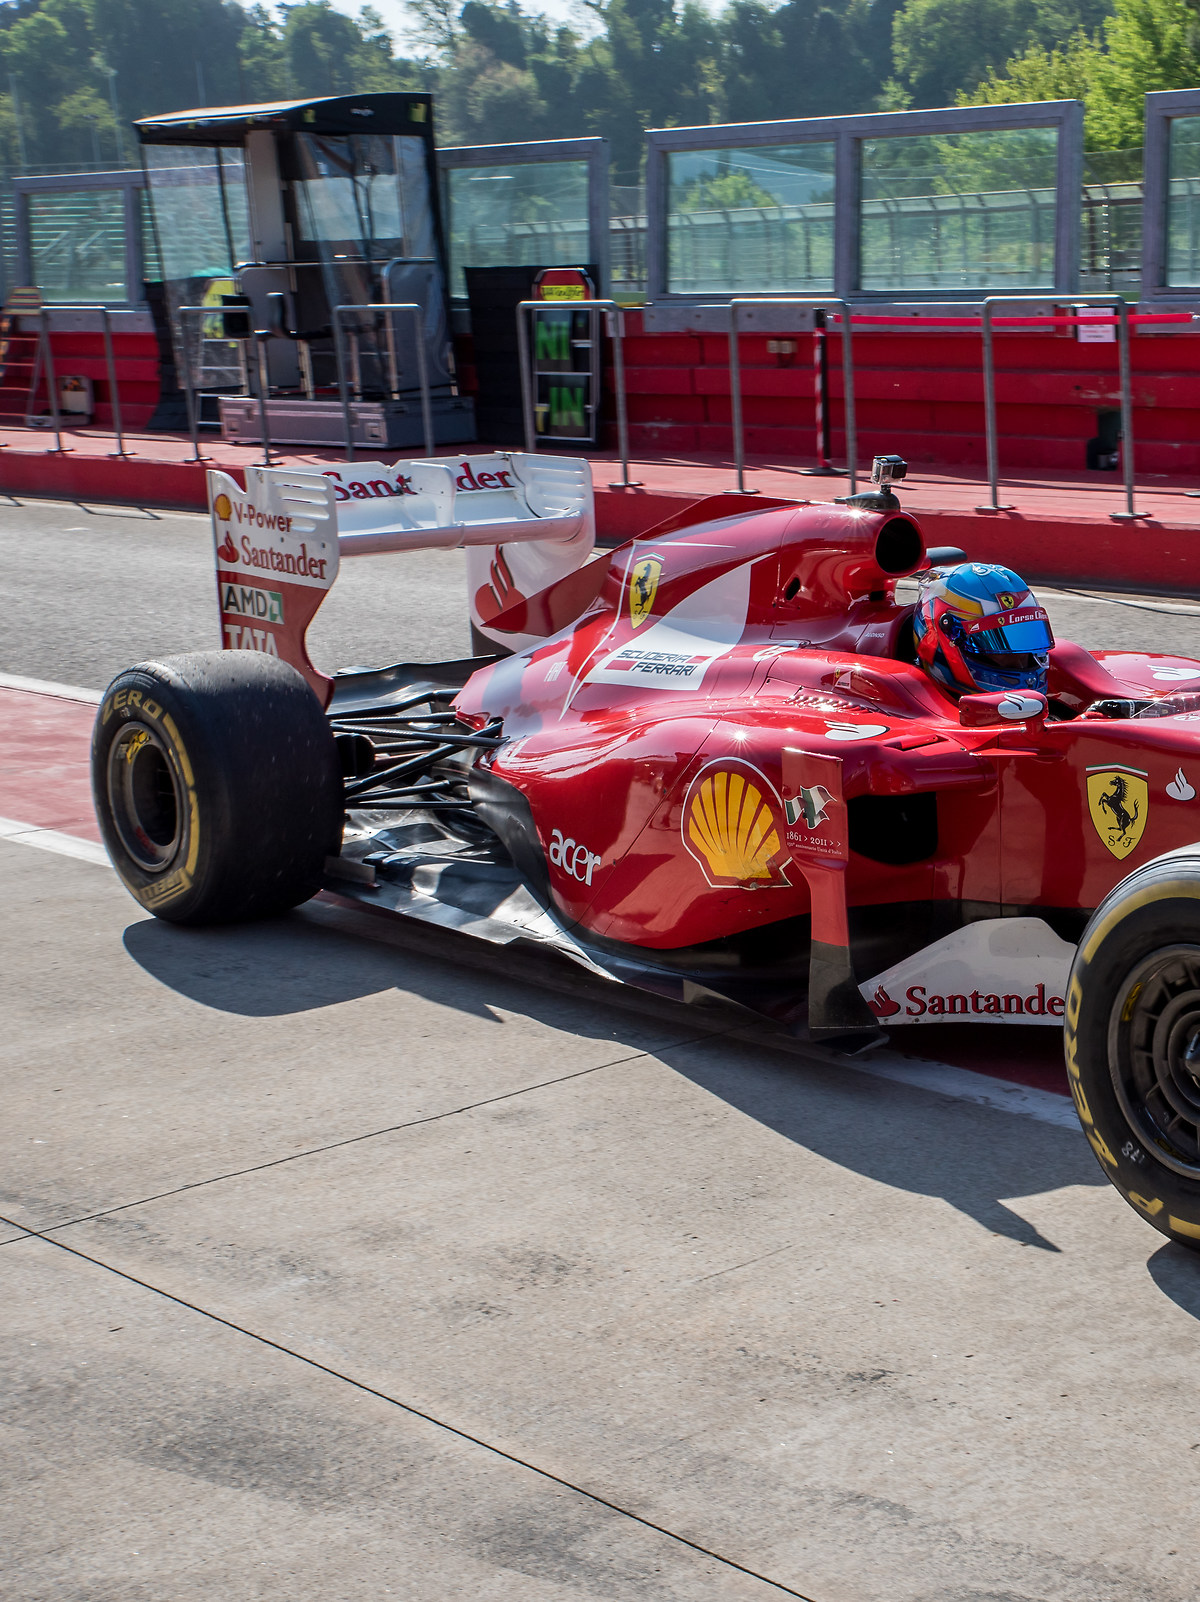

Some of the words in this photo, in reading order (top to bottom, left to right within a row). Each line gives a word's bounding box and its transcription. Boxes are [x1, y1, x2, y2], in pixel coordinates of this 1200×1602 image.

[323, 462, 515, 501] Santder
[233, 501, 293, 533] V-Power
[241, 534, 328, 580] Santander
[224, 586, 267, 617] AMD
[1009, 614, 1034, 623] Corse
[224, 624, 279, 657] TATA
[616, 649, 693, 663] SCUDERIA
[631, 661, 698, 677] FERRARI
[102, 689, 164, 726] ZERO
[786, 830, 802, 842] 1861
[810, 836, 828, 847] 2011
[1108, 835, 1115, 846] S
[1123, 836, 1136, 848] F
[549, 828, 602, 887] acer
[906, 983, 1065, 1017] Santande
